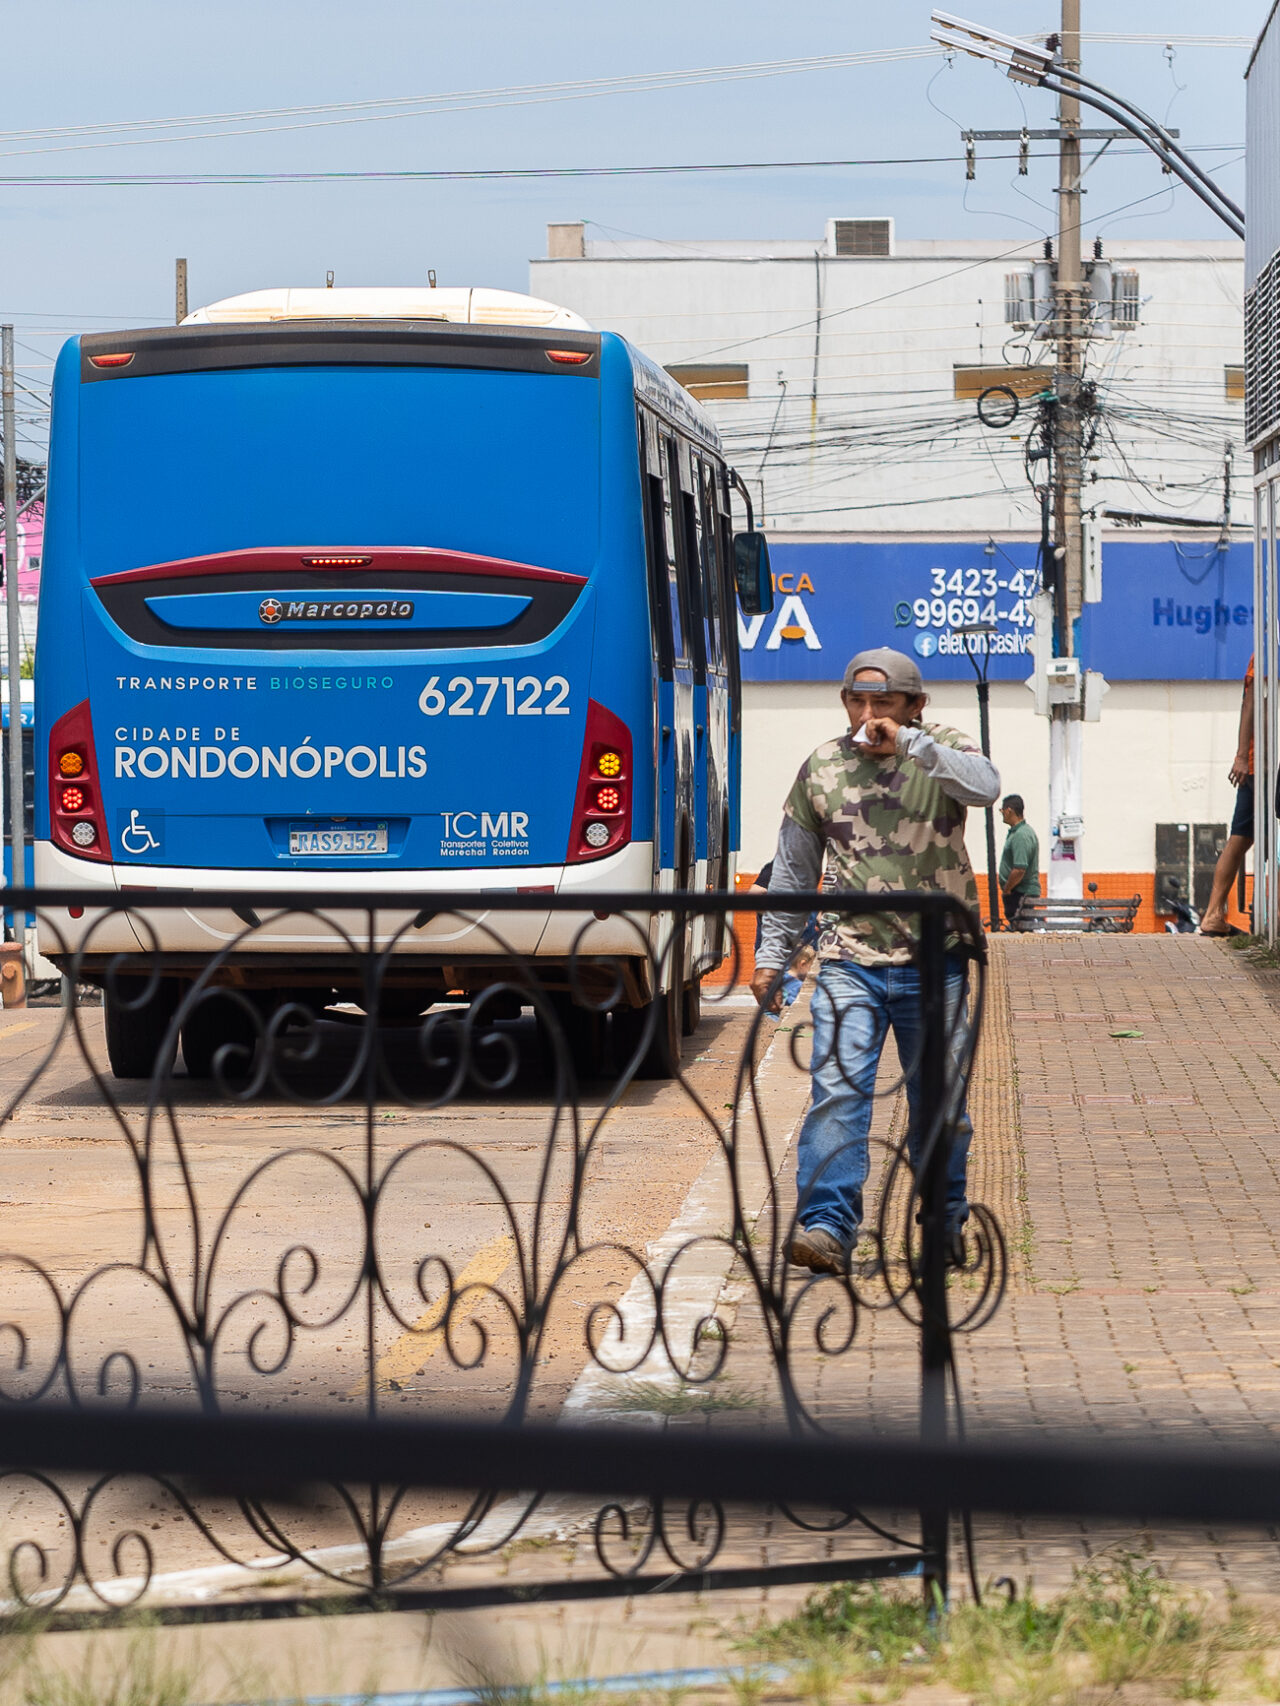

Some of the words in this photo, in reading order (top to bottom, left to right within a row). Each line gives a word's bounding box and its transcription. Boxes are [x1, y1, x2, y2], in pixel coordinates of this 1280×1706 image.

[929, 567, 1043, 597] 3423-47
[286, 600, 412, 620] Marcopolo
[1153, 598, 1254, 634] Hughe
[116, 676, 257, 690] TRANSPORTE
[270, 676, 394, 690] BIOSEGURO
[418, 675, 571, 717] 627122
[114, 726, 201, 741] CIDADE
[214, 726, 240, 741] DE
[114, 735, 428, 779] RONDONÓPOLIS
[439, 811, 530, 839] TCMR
[298, 832, 378, 852] RAS9J52
[440, 840, 487, 850] Transportes
[491, 840, 530, 849] Coletivos
[440, 848, 487, 857] Marechal
[492, 848, 530, 857] Rondon
